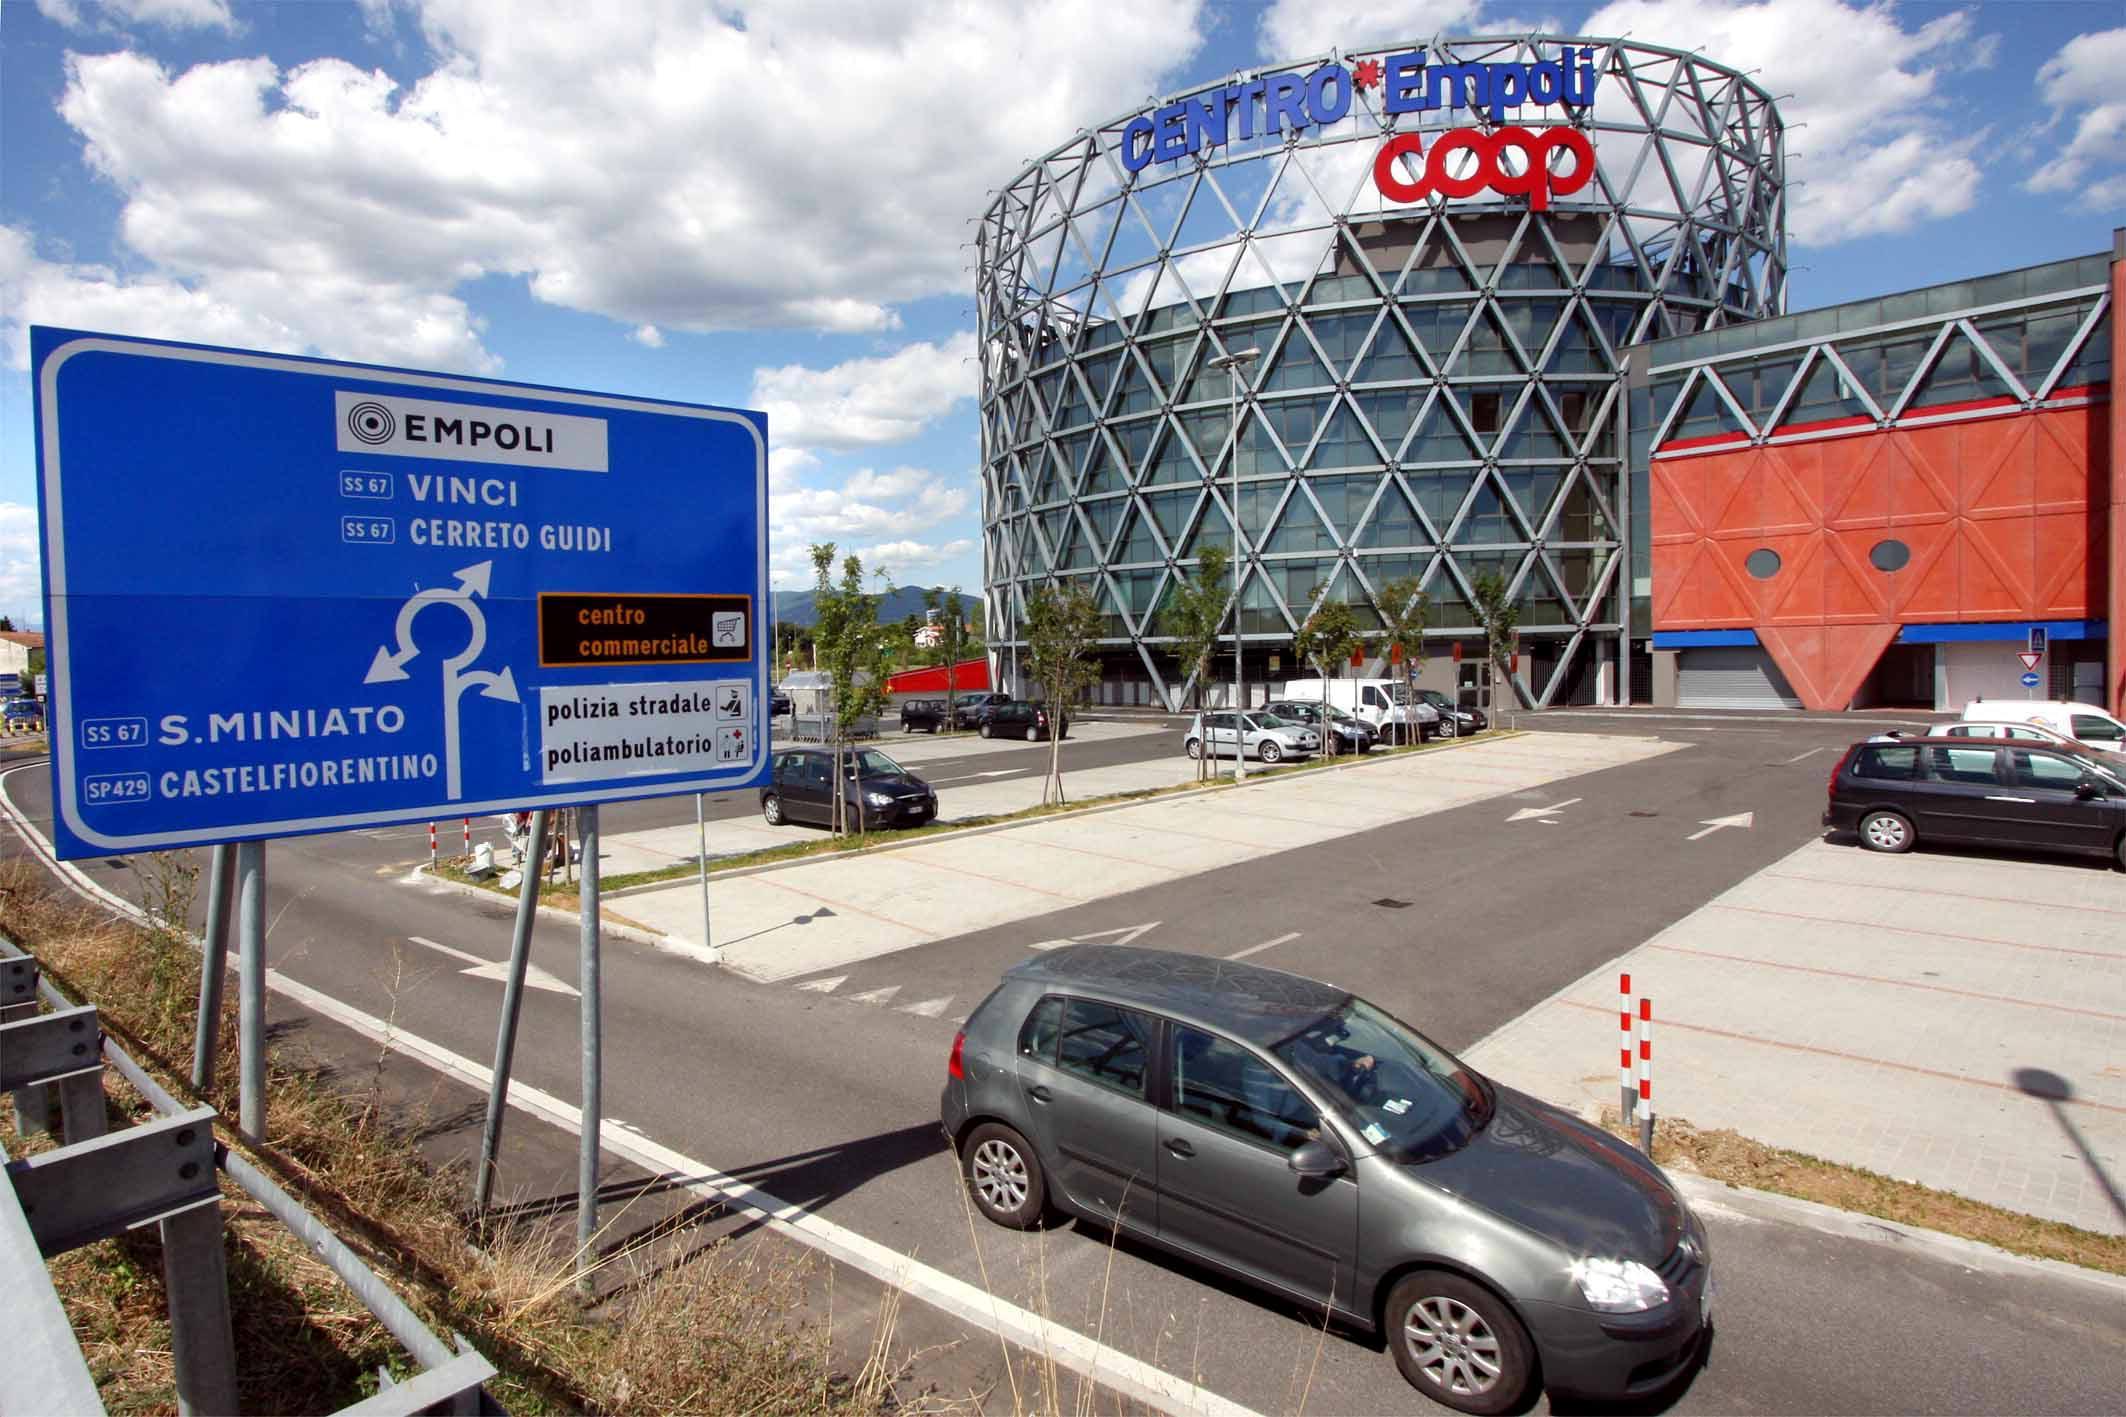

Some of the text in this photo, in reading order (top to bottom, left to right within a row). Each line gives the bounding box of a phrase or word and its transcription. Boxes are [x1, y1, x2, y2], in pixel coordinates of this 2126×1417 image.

[1120, 46, 1594, 173] CENTRO Empoli
[1373, 125, 1595, 212] coop
[404, 413, 553, 454] EMPOLI
[344, 476, 387, 494] SS 67
[407, 473, 518, 507] VINCI
[345, 522, 389, 538] SS 67
[409, 518, 611, 552] CERRETO GUIDI
[578, 604, 646, 625] centro
[578, 634, 708, 657] commerciale
[158, 705, 406, 746] S.MINIATO
[547, 691, 712, 727] polizia stradale
[87, 724, 141, 743] SS 67
[547, 734, 713, 770] poliambulatorio
[87, 779, 149, 799] SP429
[159, 753, 439, 799] CASTELFIORENTINO
